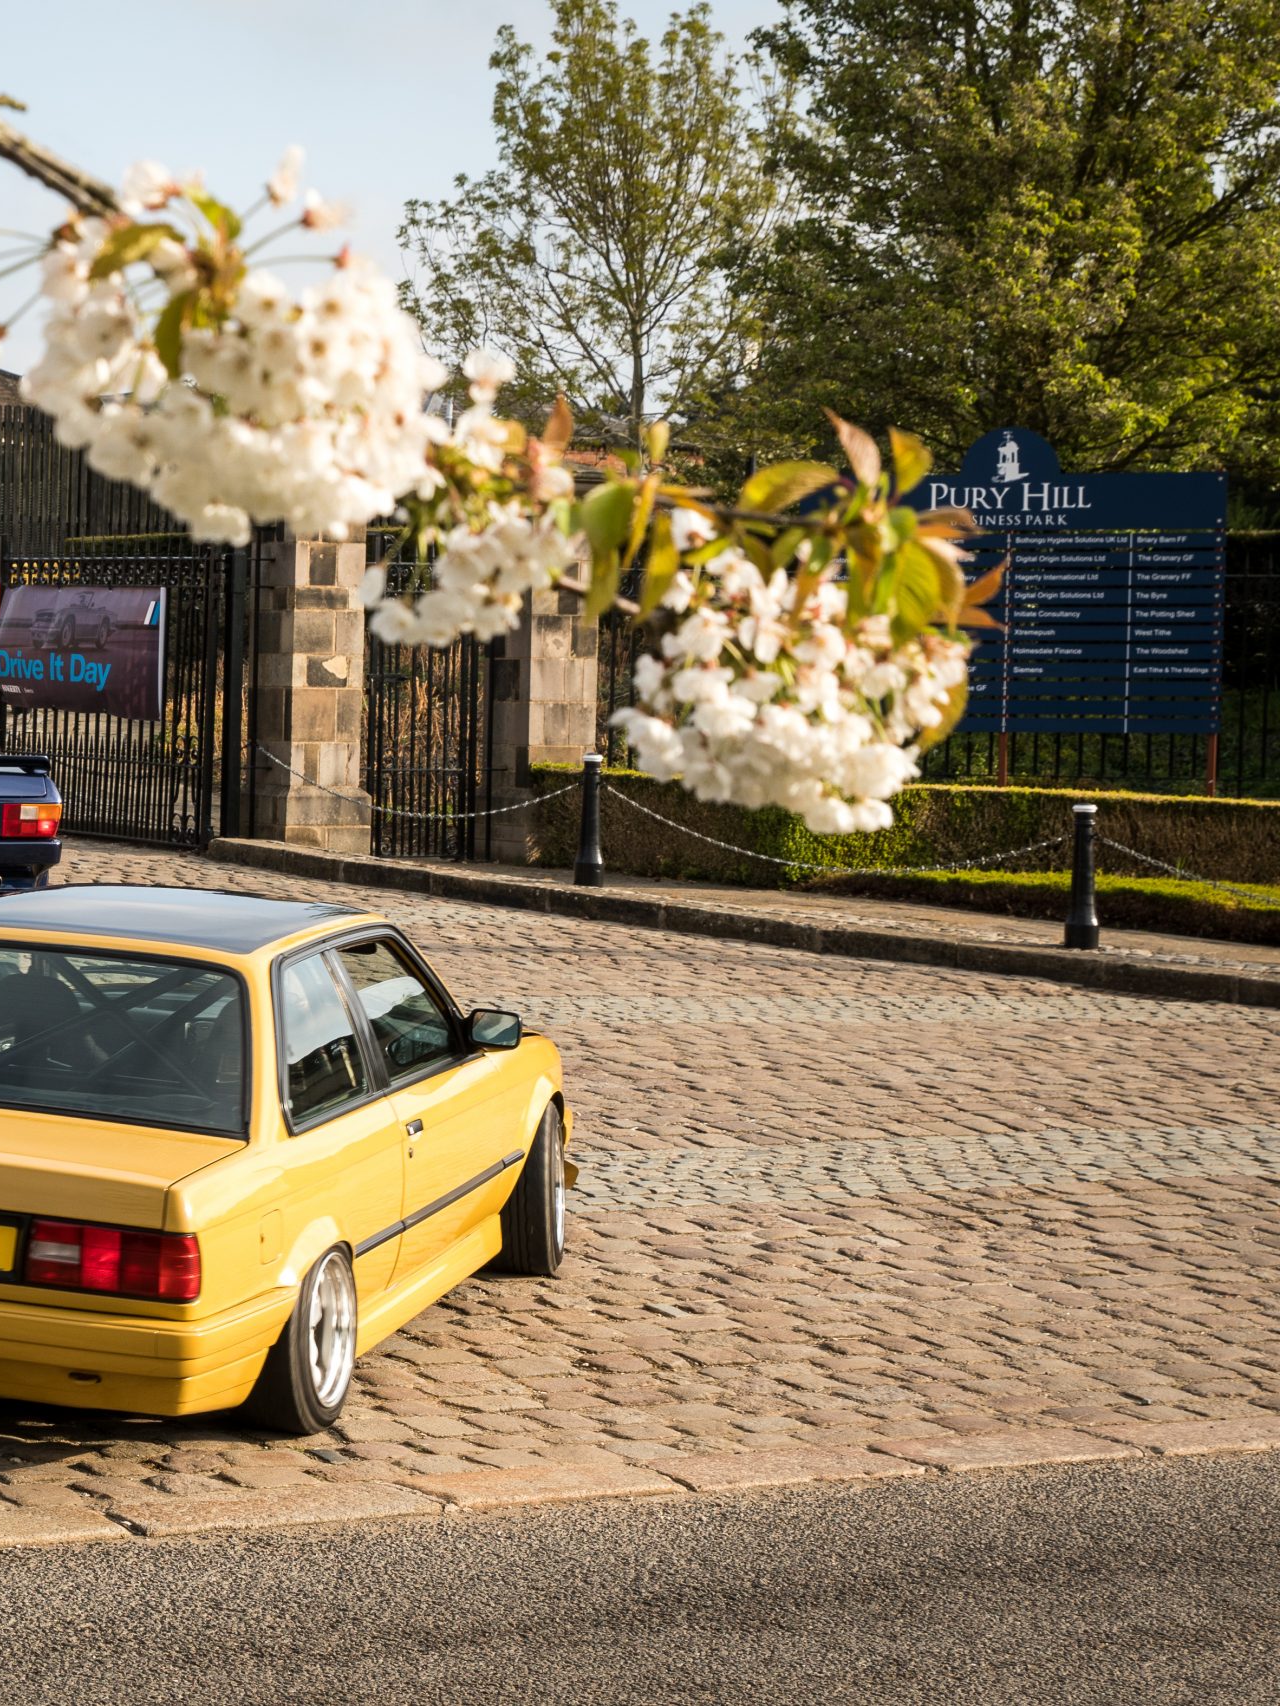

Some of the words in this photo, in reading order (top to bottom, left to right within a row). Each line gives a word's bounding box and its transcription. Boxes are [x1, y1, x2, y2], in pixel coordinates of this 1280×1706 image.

[929, 482, 1010, 511] PURY
[1021, 482, 1092, 511] HILL
[951, 514, 1021, 526] SINESS
[1025, 514, 1068, 526] PARK
[1015, 555, 1038, 564] Digital
[1039, 555, 1060, 564] Origin
[1061, 555, 1093, 563] Solutions
[1094, 555, 1106, 563] Ltd
[1138, 554, 1151, 562] The
[1153, 554, 1181, 563] Granary
[1182, 554, 1195, 562] GF
[1015, 573, 1042, 582] Hagerty
[1043, 573, 1086, 581] International
[1087, 573, 1099, 581] Ltd
[1151, 573, 1180, 582] Granary
[1014, 591, 1036, 600] Digital
[1037, 591, 1058, 600] Origin
[1060, 591, 1091, 599] Solutions
[1093, 591, 1105, 599] Ltd
[1038, 610, 1081, 619] Consultancy
[1054, 647, 1082, 655] Finance
[1136, 647, 1149, 655] The
[1150, 647, 1189, 655] Woodshed
[49, 652, 65, 683] It
[70, 653, 112, 692] Day
[1012, 666, 1044, 674] Siemens
